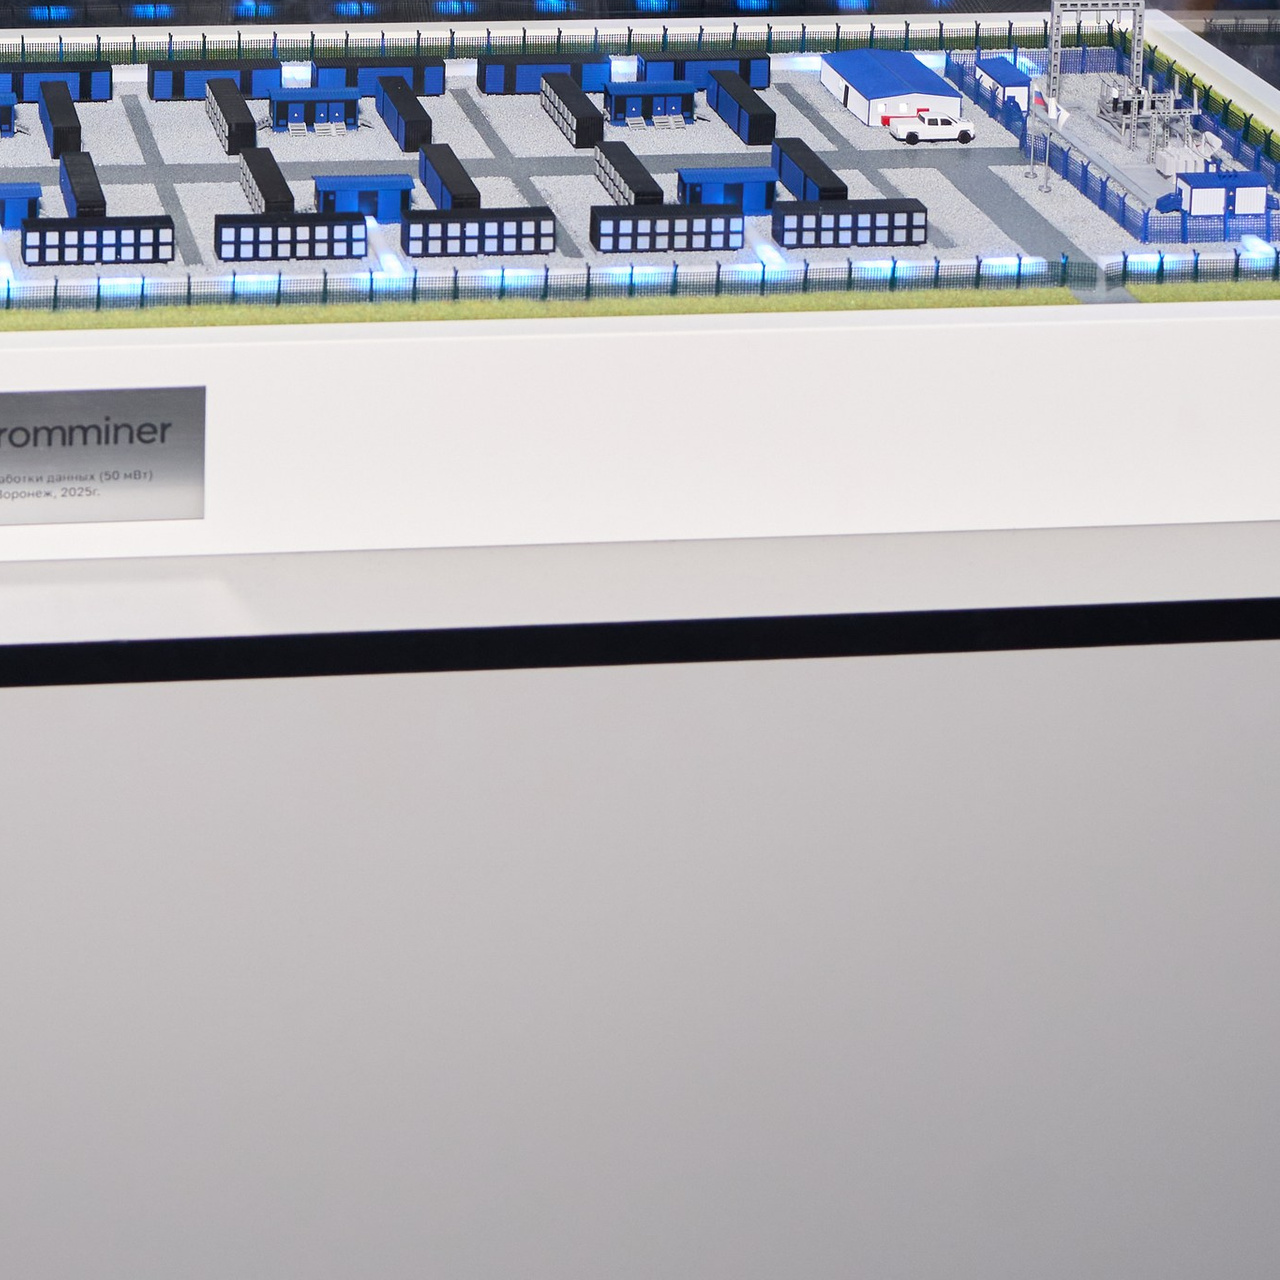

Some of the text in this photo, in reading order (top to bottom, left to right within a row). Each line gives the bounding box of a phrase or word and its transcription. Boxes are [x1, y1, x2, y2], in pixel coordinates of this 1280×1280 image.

[46, 472, 95, 483] данных
[99, 469, 120, 483] (50
[60, 486, 101, 497] 2025г.
